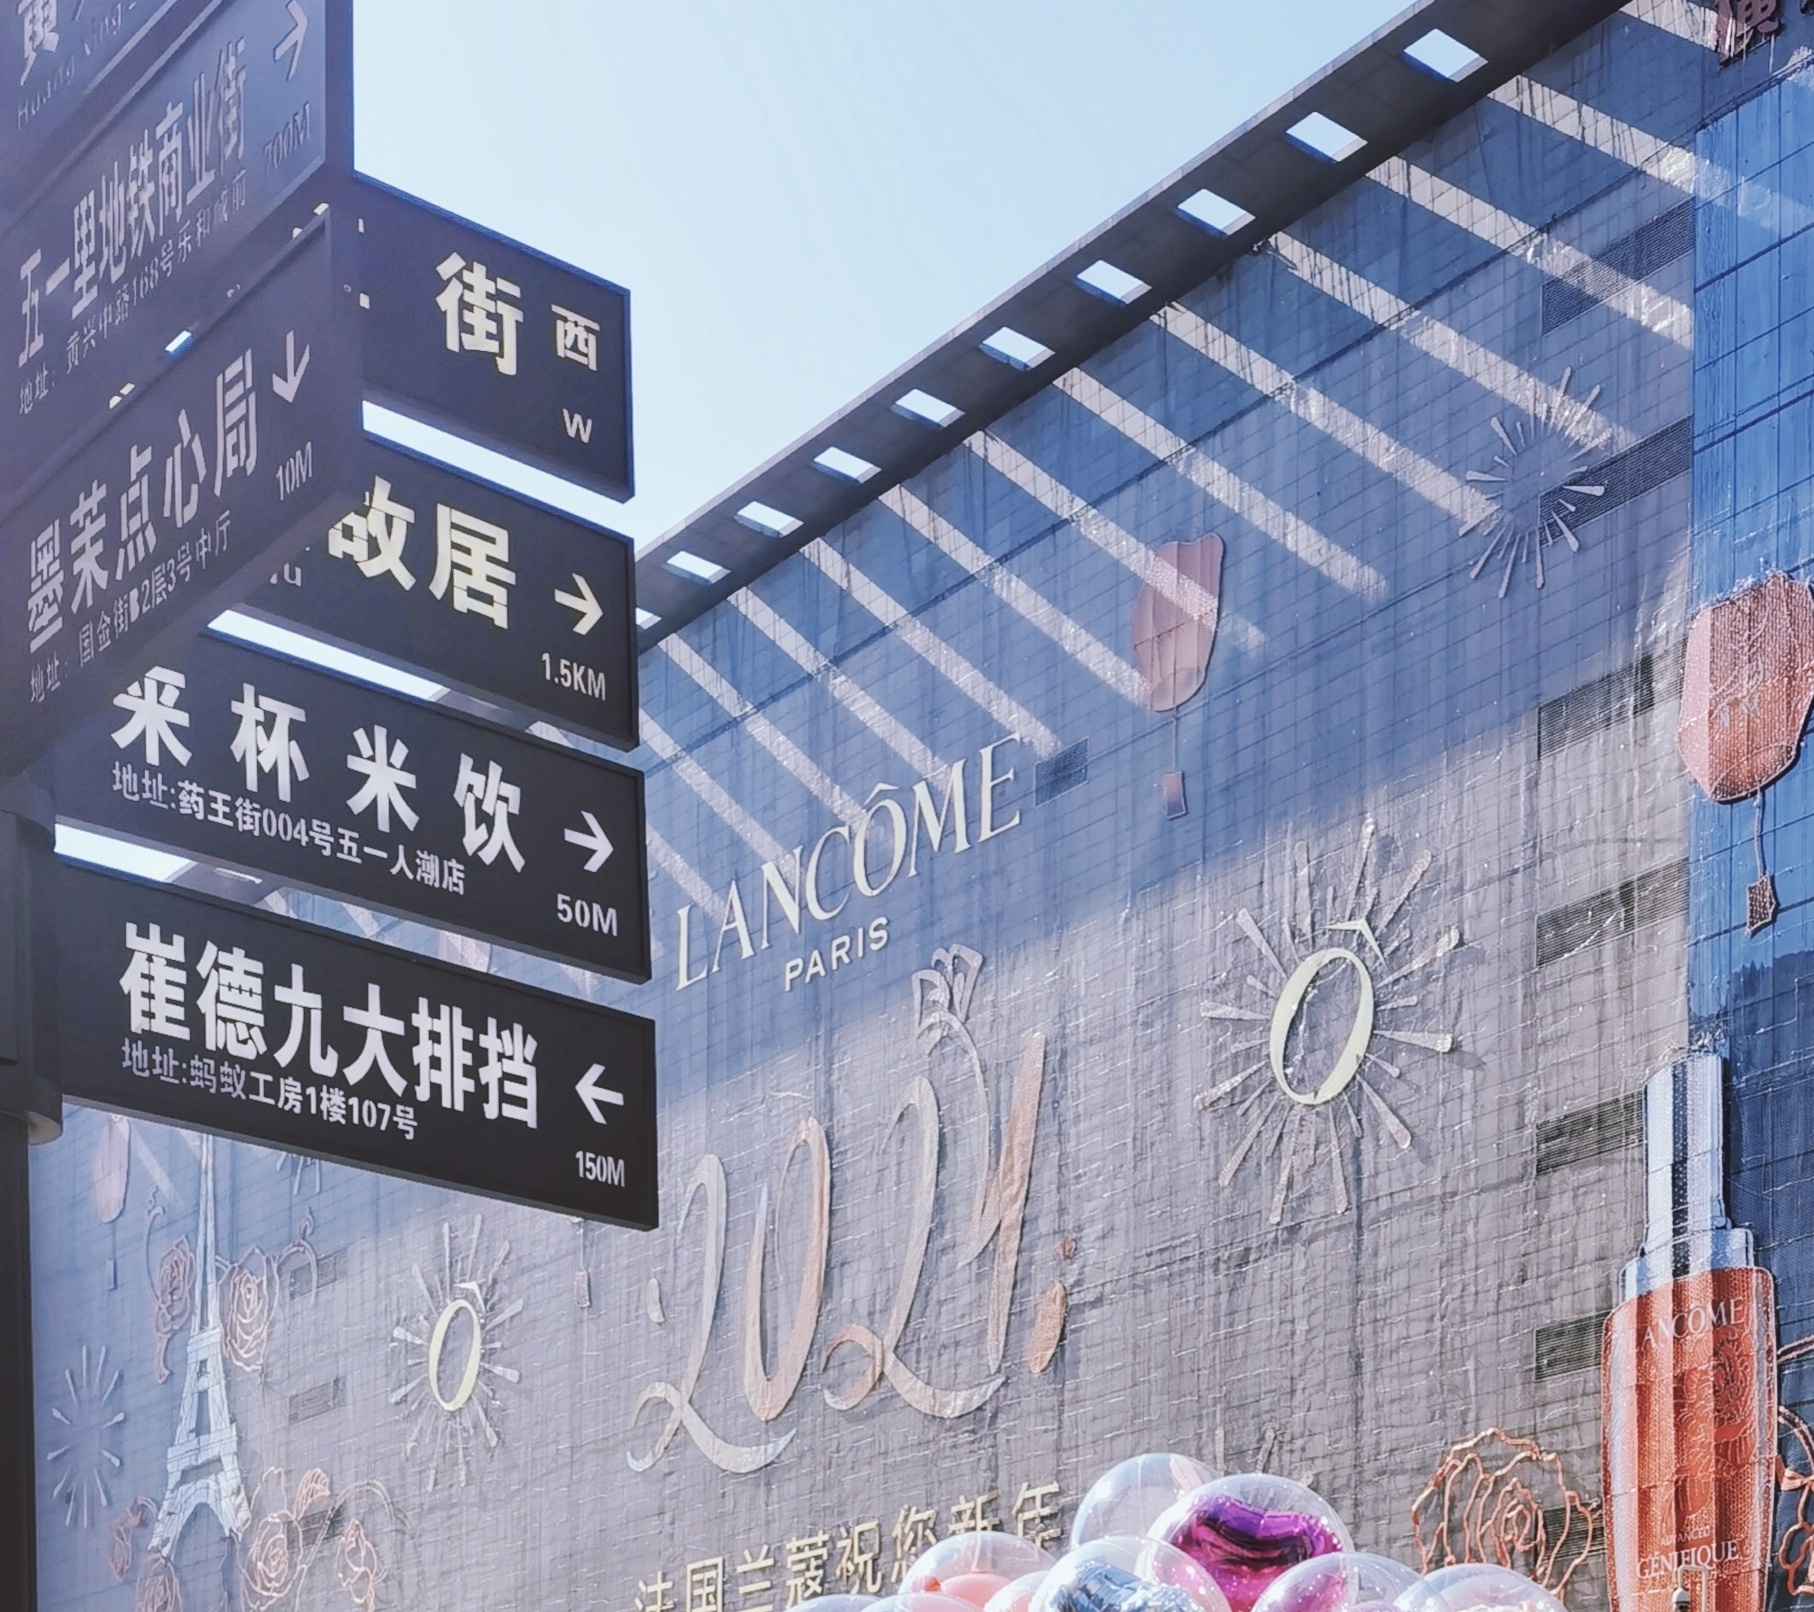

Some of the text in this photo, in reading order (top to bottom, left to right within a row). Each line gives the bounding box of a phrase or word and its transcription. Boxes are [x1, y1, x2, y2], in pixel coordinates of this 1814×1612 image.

[18, 36, 247, 368] 五一里地铁商业街
[551, 303, 600, 371] 西
[562, 408, 593, 444] W
[27, 348, 258, 654] 墨茉点心局
[275, 441, 313, 501] 10M
[328, 475, 516, 630] 故居
[541, 652, 606, 701] 1.5KM
[675, 731, 1022, 992] LANCÔME
[556, 894, 618, 937] 50M
[784, 916, 890, 993] PARIS
[119, 921, 538, 1129] 崔德九大排挡
[575, 1150, 626, 1188] 150M
[1640, 1297, 1746, 1351] ANCÔME
